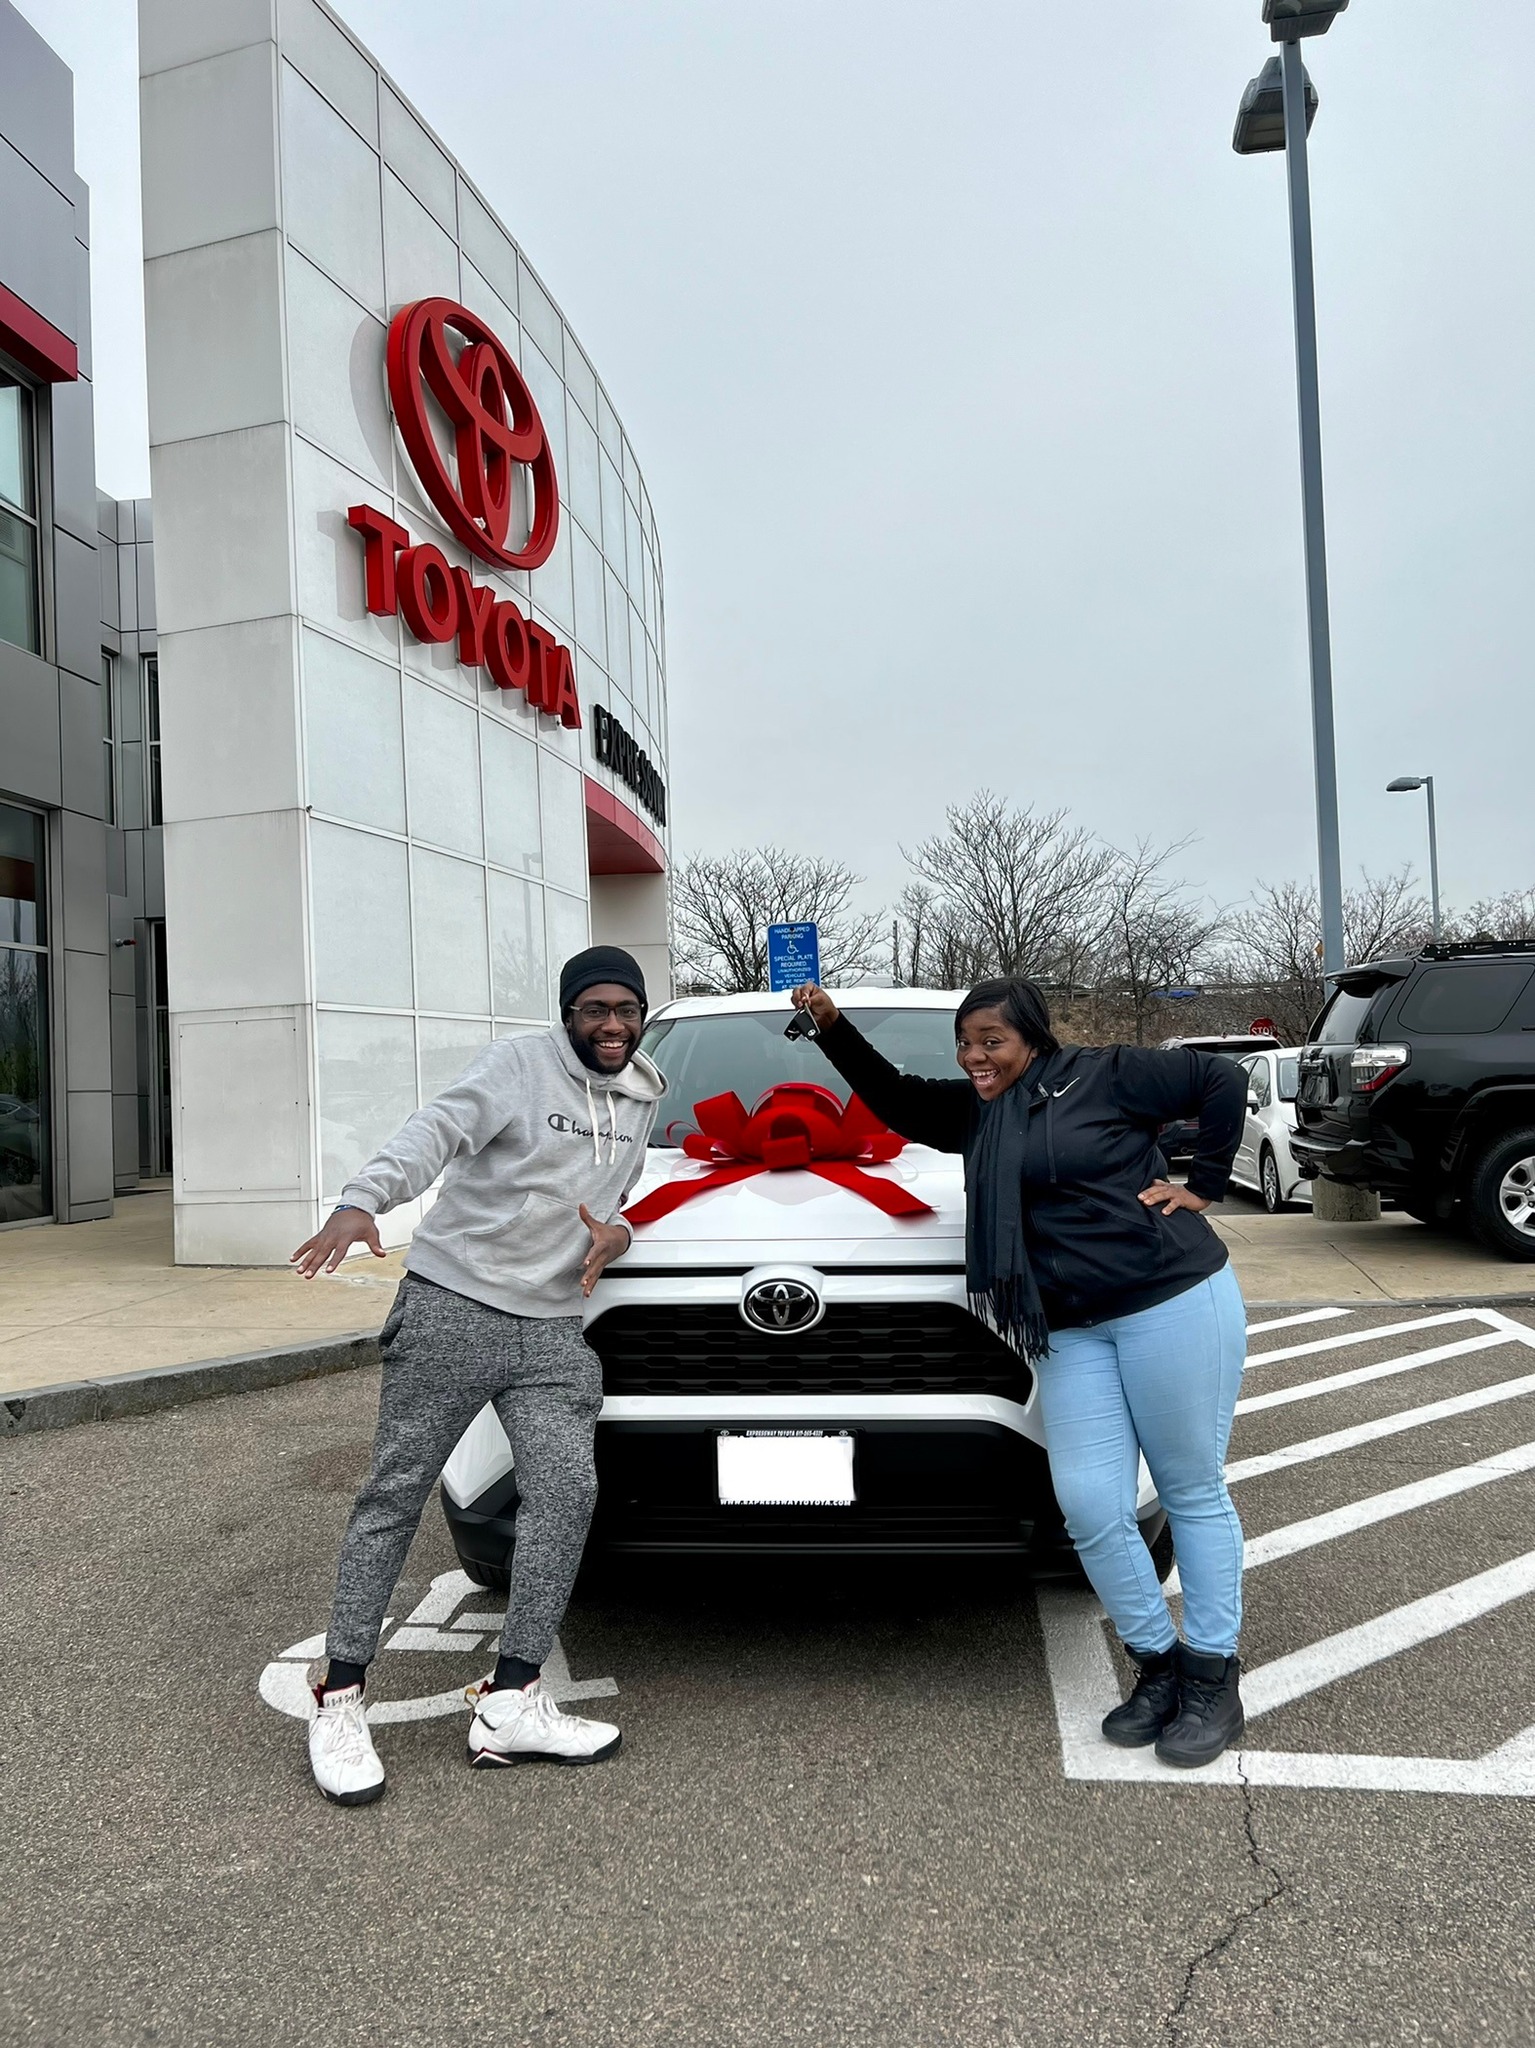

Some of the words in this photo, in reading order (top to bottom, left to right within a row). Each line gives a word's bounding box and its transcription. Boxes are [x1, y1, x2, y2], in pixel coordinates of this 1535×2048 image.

[348, 504, 582, 729] TOYOTA
[594, 703, 666, 827] EXPRESSW
[774, 926, 810, 934] HANDIAPPED
